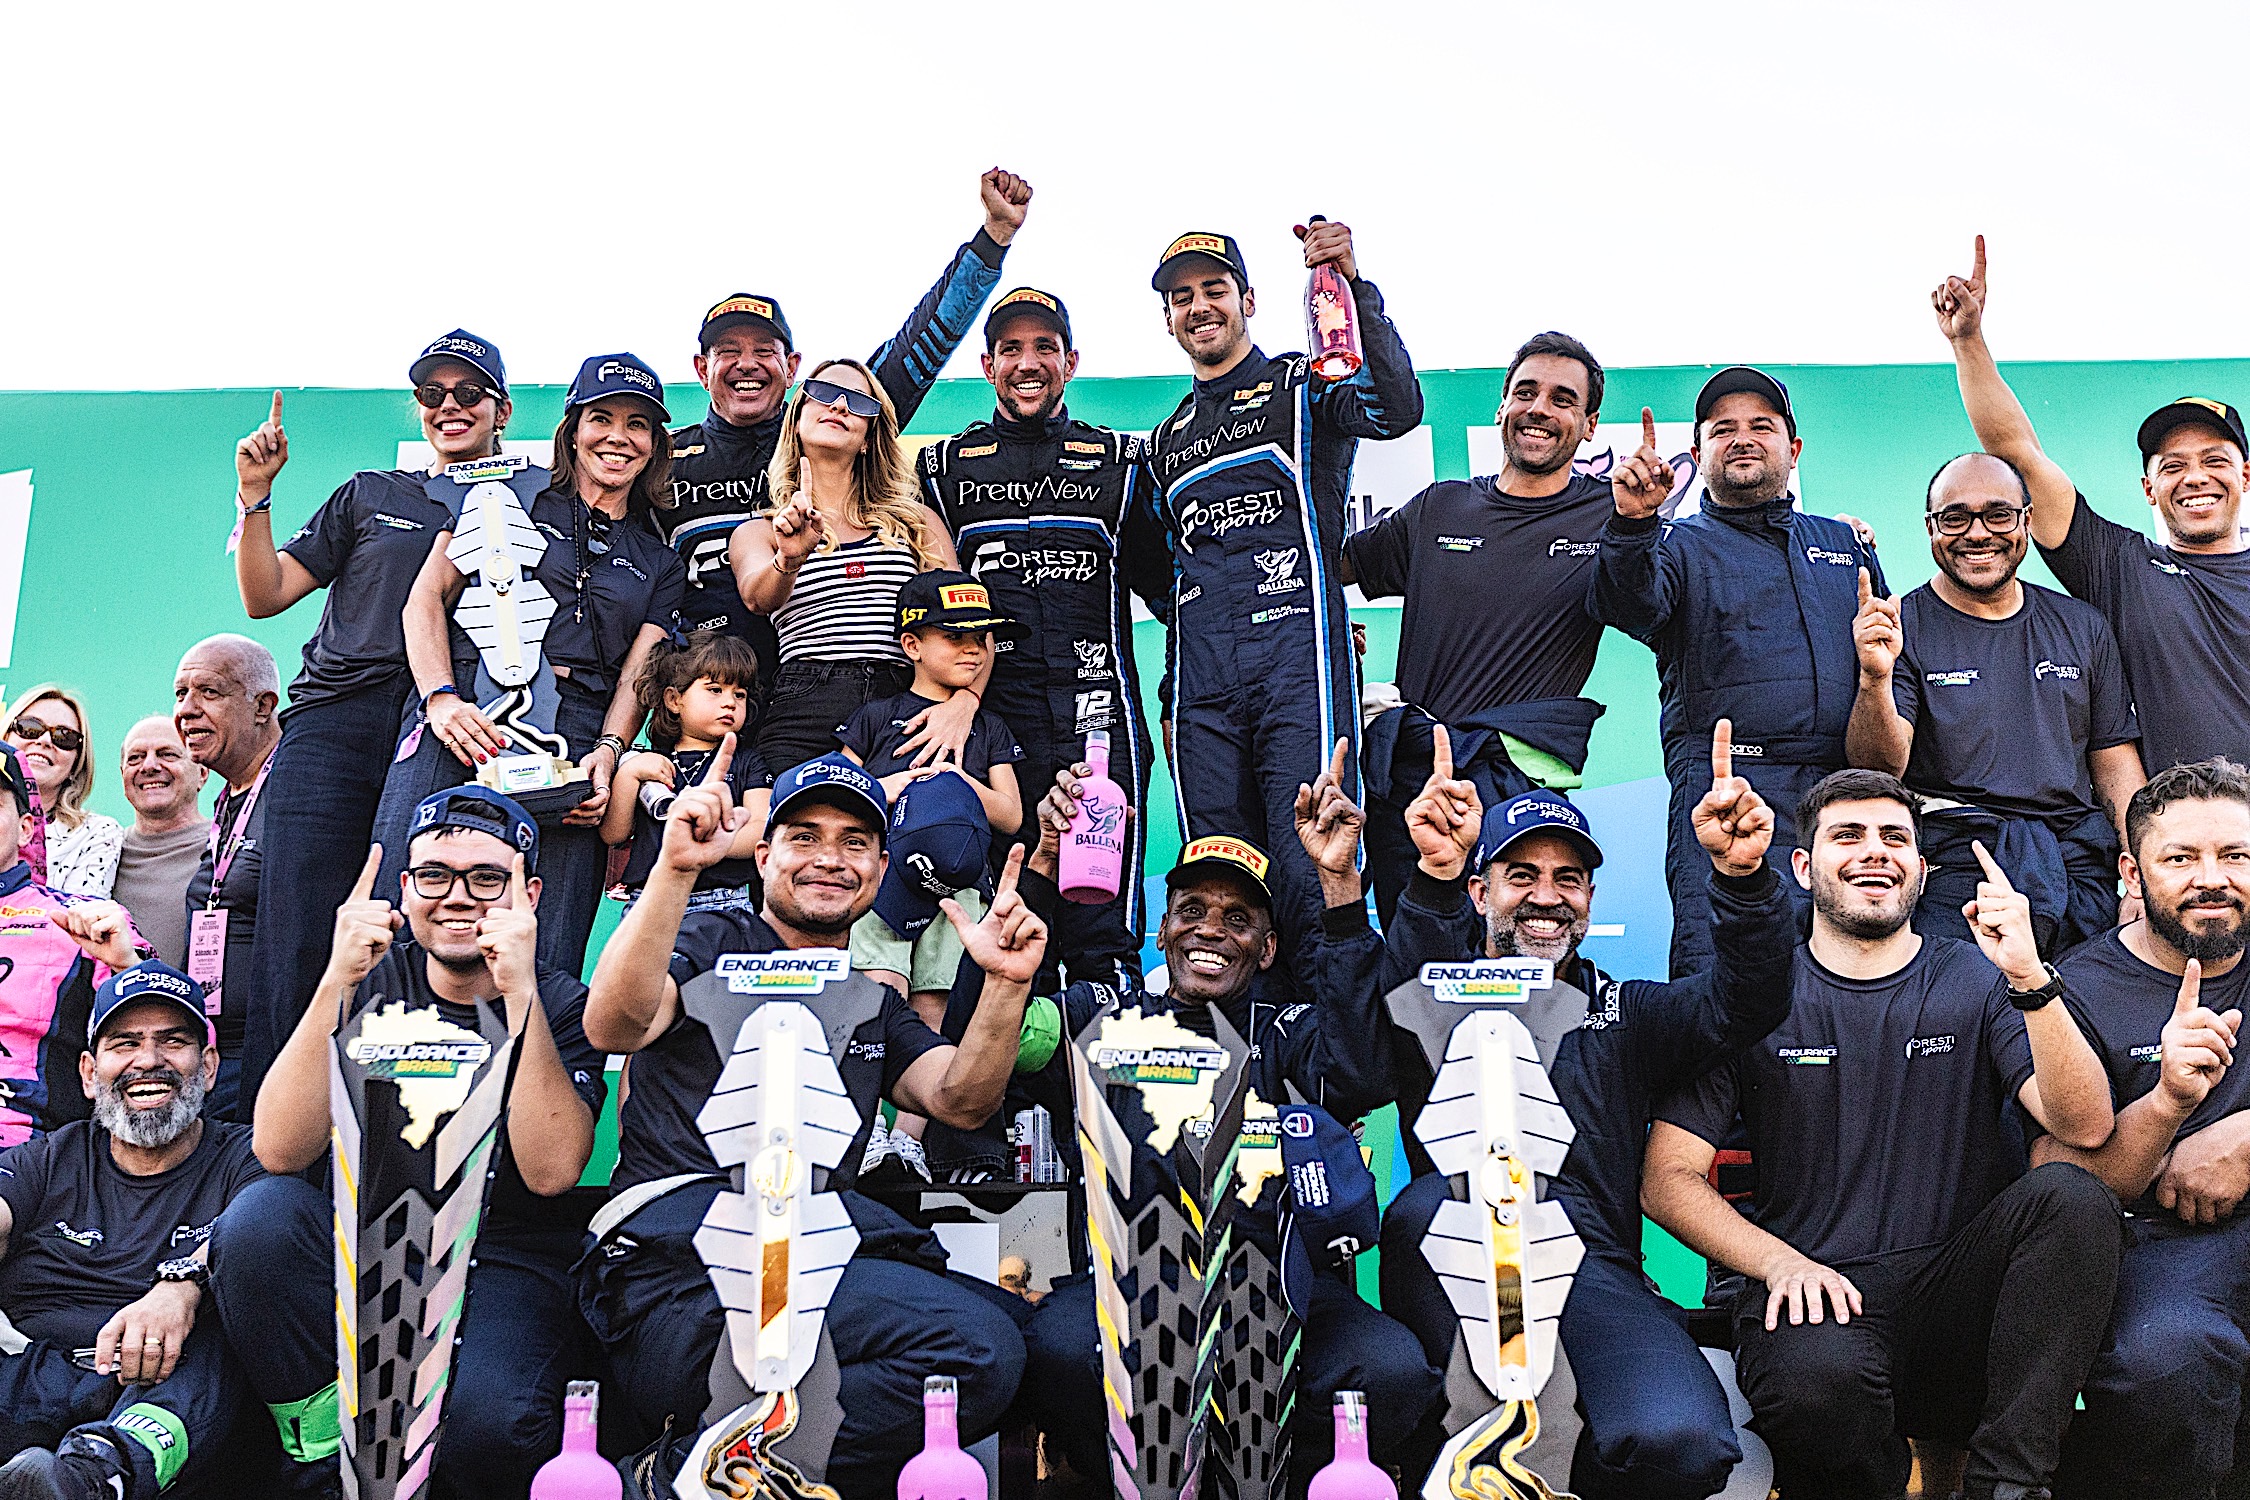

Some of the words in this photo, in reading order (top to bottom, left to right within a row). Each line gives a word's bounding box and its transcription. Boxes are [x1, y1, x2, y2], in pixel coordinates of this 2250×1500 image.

[429, 336, 486, 356] FORESTI
[598, 361, 657, 388] FORESTI
[623, 373, 656, 391] sports
[1165, 416, 1266, 476] PrettyNew
[448, 457, 523, 473] ENDURANCE
[472, 467, 510, 477] BRASIL
[959, 476, 1101, 506] PrettyNew
[375, 512, 426, 530] ENDURANCE
[1181, 490, 1284, 554] FORESTI
[1211, 506, 1283, 537] sports
[1437, 536, 1485, 548] ENDURANCE
[1549, 539, 1600, 557] FORESTI
[971, 541, 1098, 582] FORESTI
[1022, 562, 1098, 587] sports
[1257, 577, 1306, 595] BALLENA
[697, 616, 729, 631] parco
[901, 606, 928, 627] 1ST
[1077, 668, 1114, 679] BALLENA
[1927, 669, 1980, 681] ENDURANCE
[1075, 689, 1113, 718] 12
[1729, 745, 1763, 756] parco
[796, 762, 872, 788] FORESTI
[828, 772, 871, 790] sports
[1507, 799, 1580, 825] FORESTI
[1539, 809, 1580, 827] sports
[1075, 833, 1121, 854] BALLENA
[1190, 843, 1262, 871] PIRELLI
[722, 958, 841, 972] ENDURANCE
[115, 969, 192, 996] FORESTI
[758, 974, 817, 986] BRASIL
[1427, 968, 1544, 981] ENDURANCE
[146, 980, 190, 995] sports
[1464, 983, 1521, 994] BRASIL
[357, 1043, 485, 1062] ENDURANCE
[1097, 1048, 1223, 1069] ENDURANCE
[1778, 1048, 1838, 1057] ENDURANCE
[1921, 1043, 1954, 1056] sports
[394, 1060, 455, 1073] BRASIL
[1136, 1065, 1195, 1080] BRASIL
